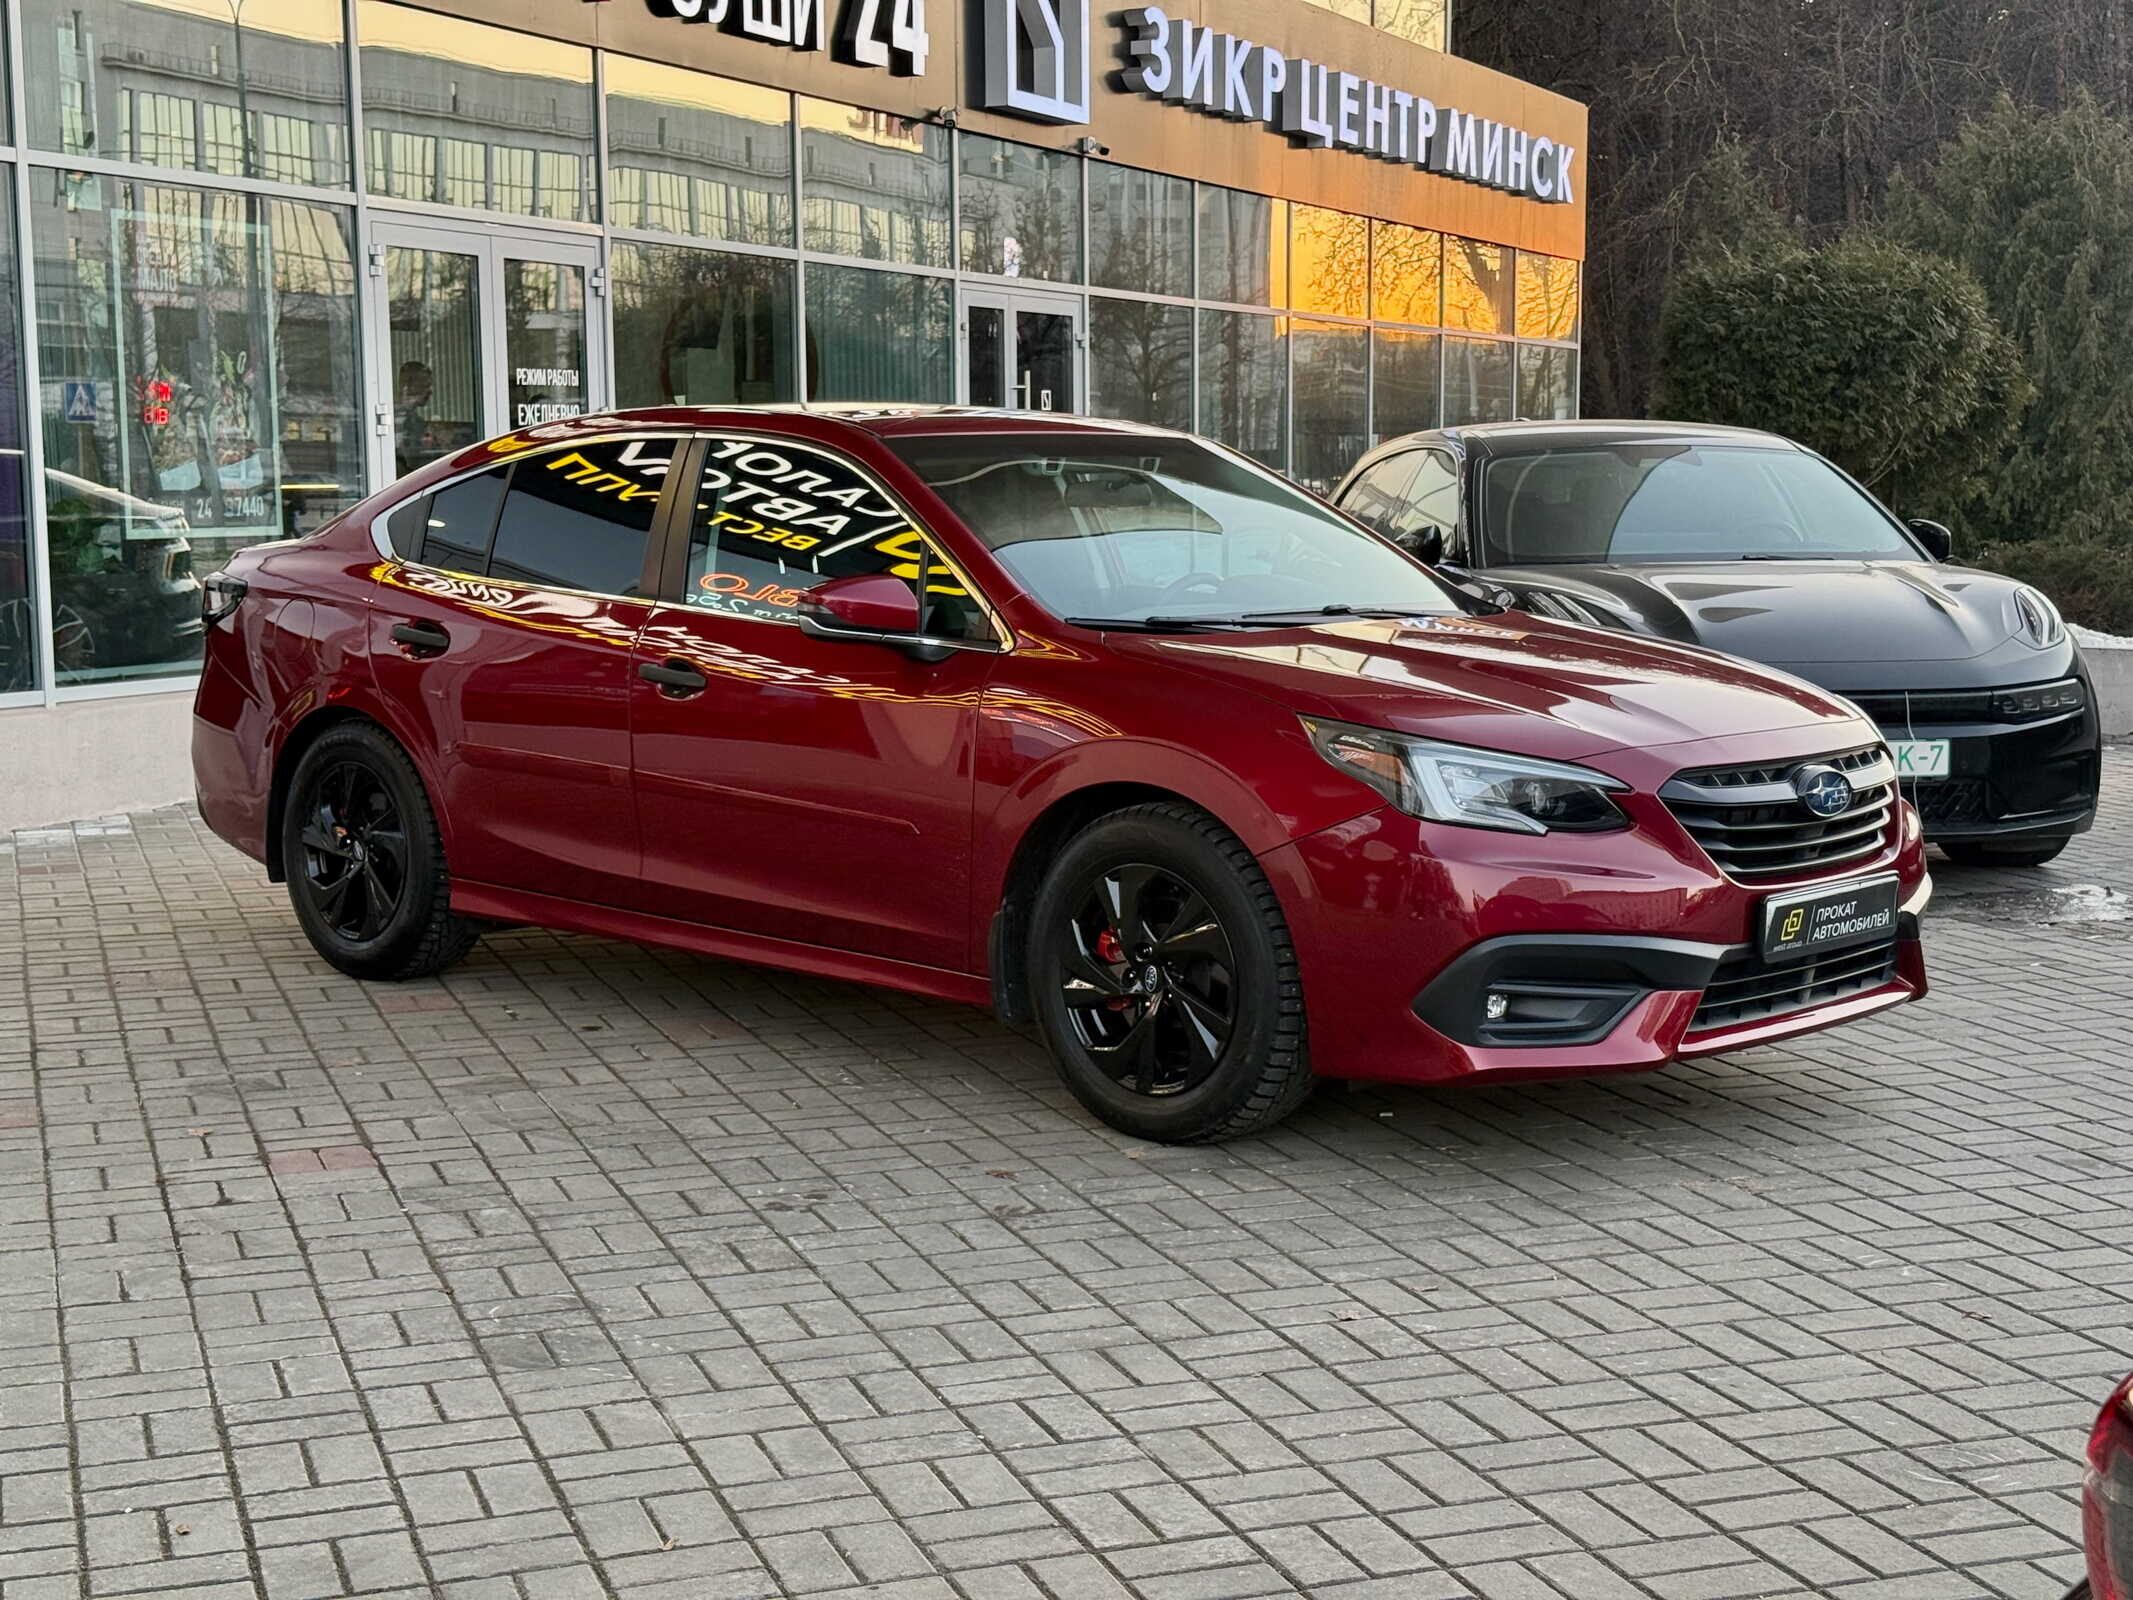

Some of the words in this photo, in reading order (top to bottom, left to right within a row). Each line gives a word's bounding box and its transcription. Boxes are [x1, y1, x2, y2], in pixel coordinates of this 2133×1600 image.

[855, 0, 928, 76] 24
[1142, 6, 1286, 121] ЗИКР
[1301, 59, 1437, 163] ЦЕНТР
[1446, 109, 1575, 203] МИНСК
[516, 368, 546, 386] РЕЖИМ
[547, 369, 579, 387] РАБОТЫ
[1812, 908, 1890, 941] АВТОМОБИЛЕЙ
[1816, 901, 1858, 922] ПРОКАТ
